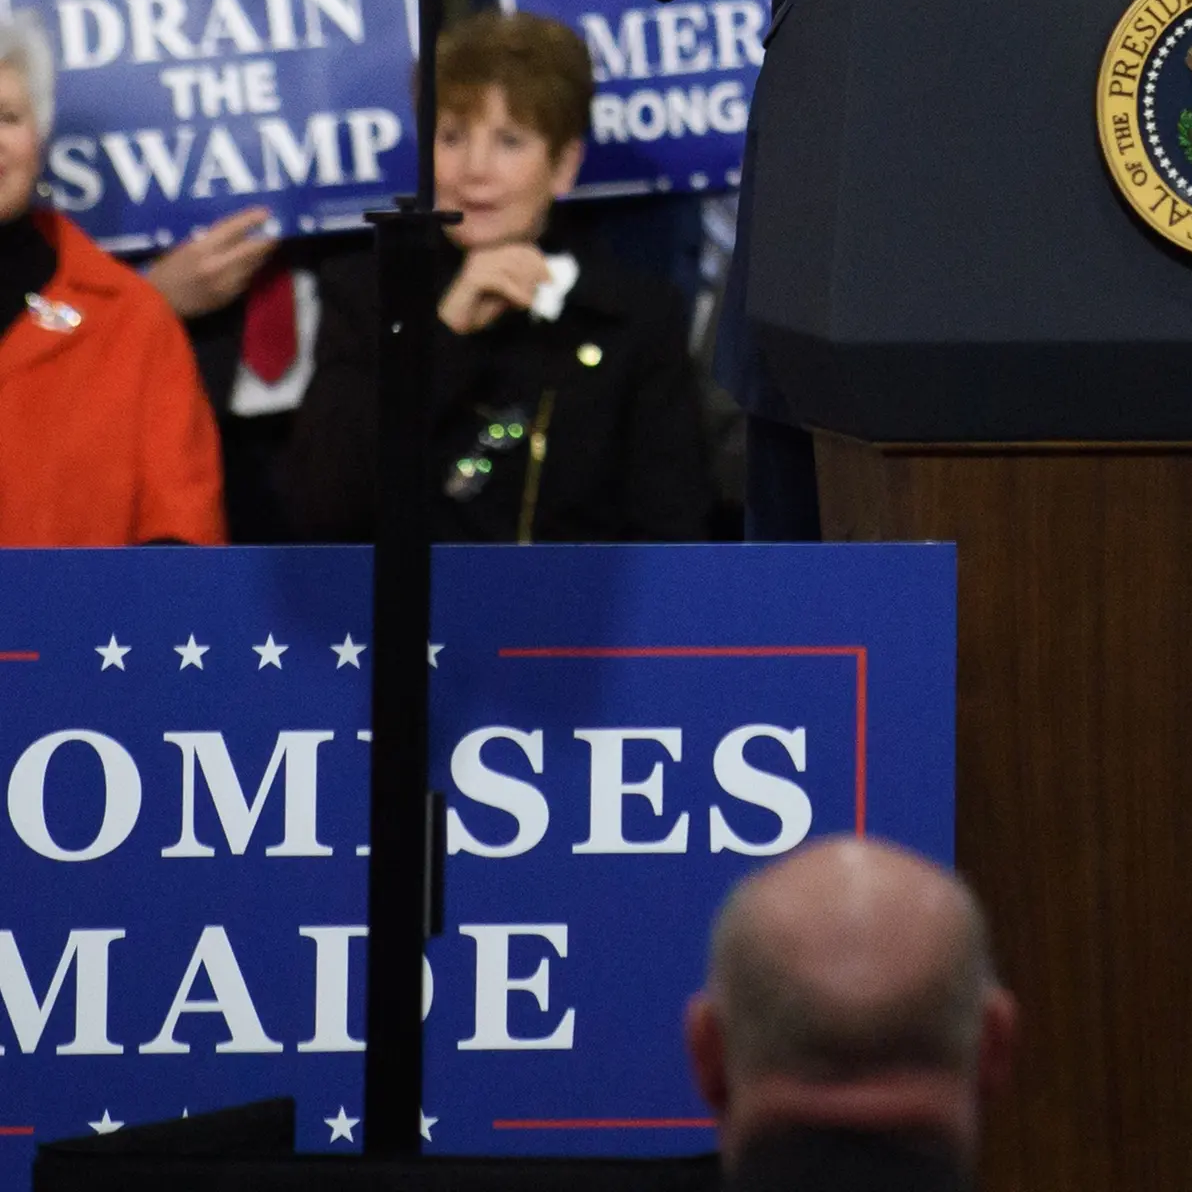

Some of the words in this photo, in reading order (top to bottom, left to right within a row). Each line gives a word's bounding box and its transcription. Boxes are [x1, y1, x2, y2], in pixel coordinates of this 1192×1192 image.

[160, 58, 281, 121] THE
[590, 80, 748, 145] RONG
[48, 107, 401, 211] SWAMP
[1112, 112, 1135, 155] THE
[1125, 160, 1148, 188] OF
[7, 723, 813, 861] OMSES
